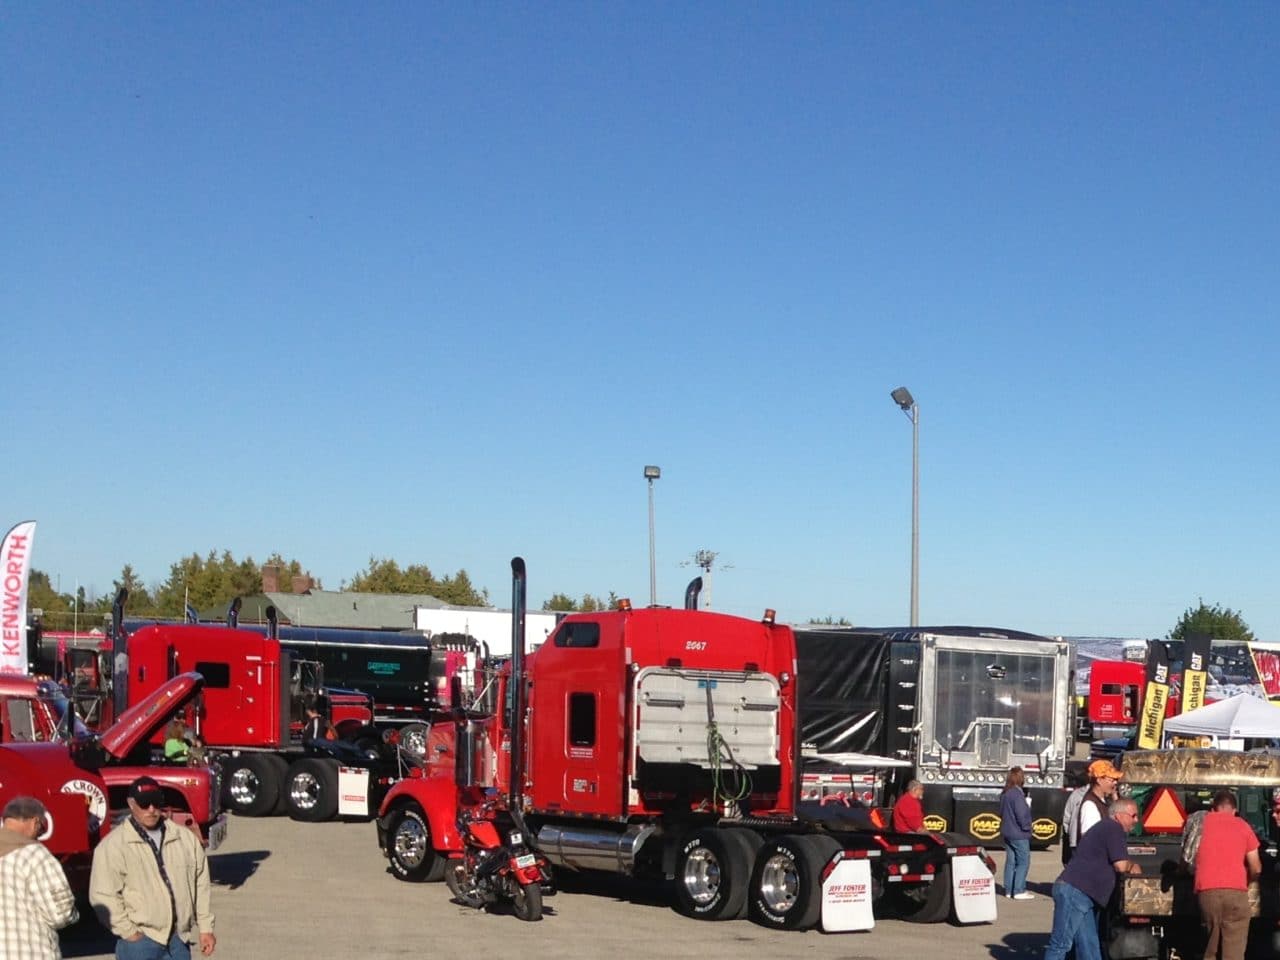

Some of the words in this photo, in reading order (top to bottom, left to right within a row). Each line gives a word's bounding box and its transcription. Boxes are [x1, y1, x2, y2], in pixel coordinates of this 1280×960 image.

[2, 535, 27, 656] KENWORTH
[1191, 652, 1203, 670] CAT
[1155, 664, 1169, 683] CAT
[1187, 674, 1202, 713] ichigan
[1144, 688, 1164, 740] Michigan
[73, 781, 104, 804] CROWN
[974, 820, 1001, 829] MAC
